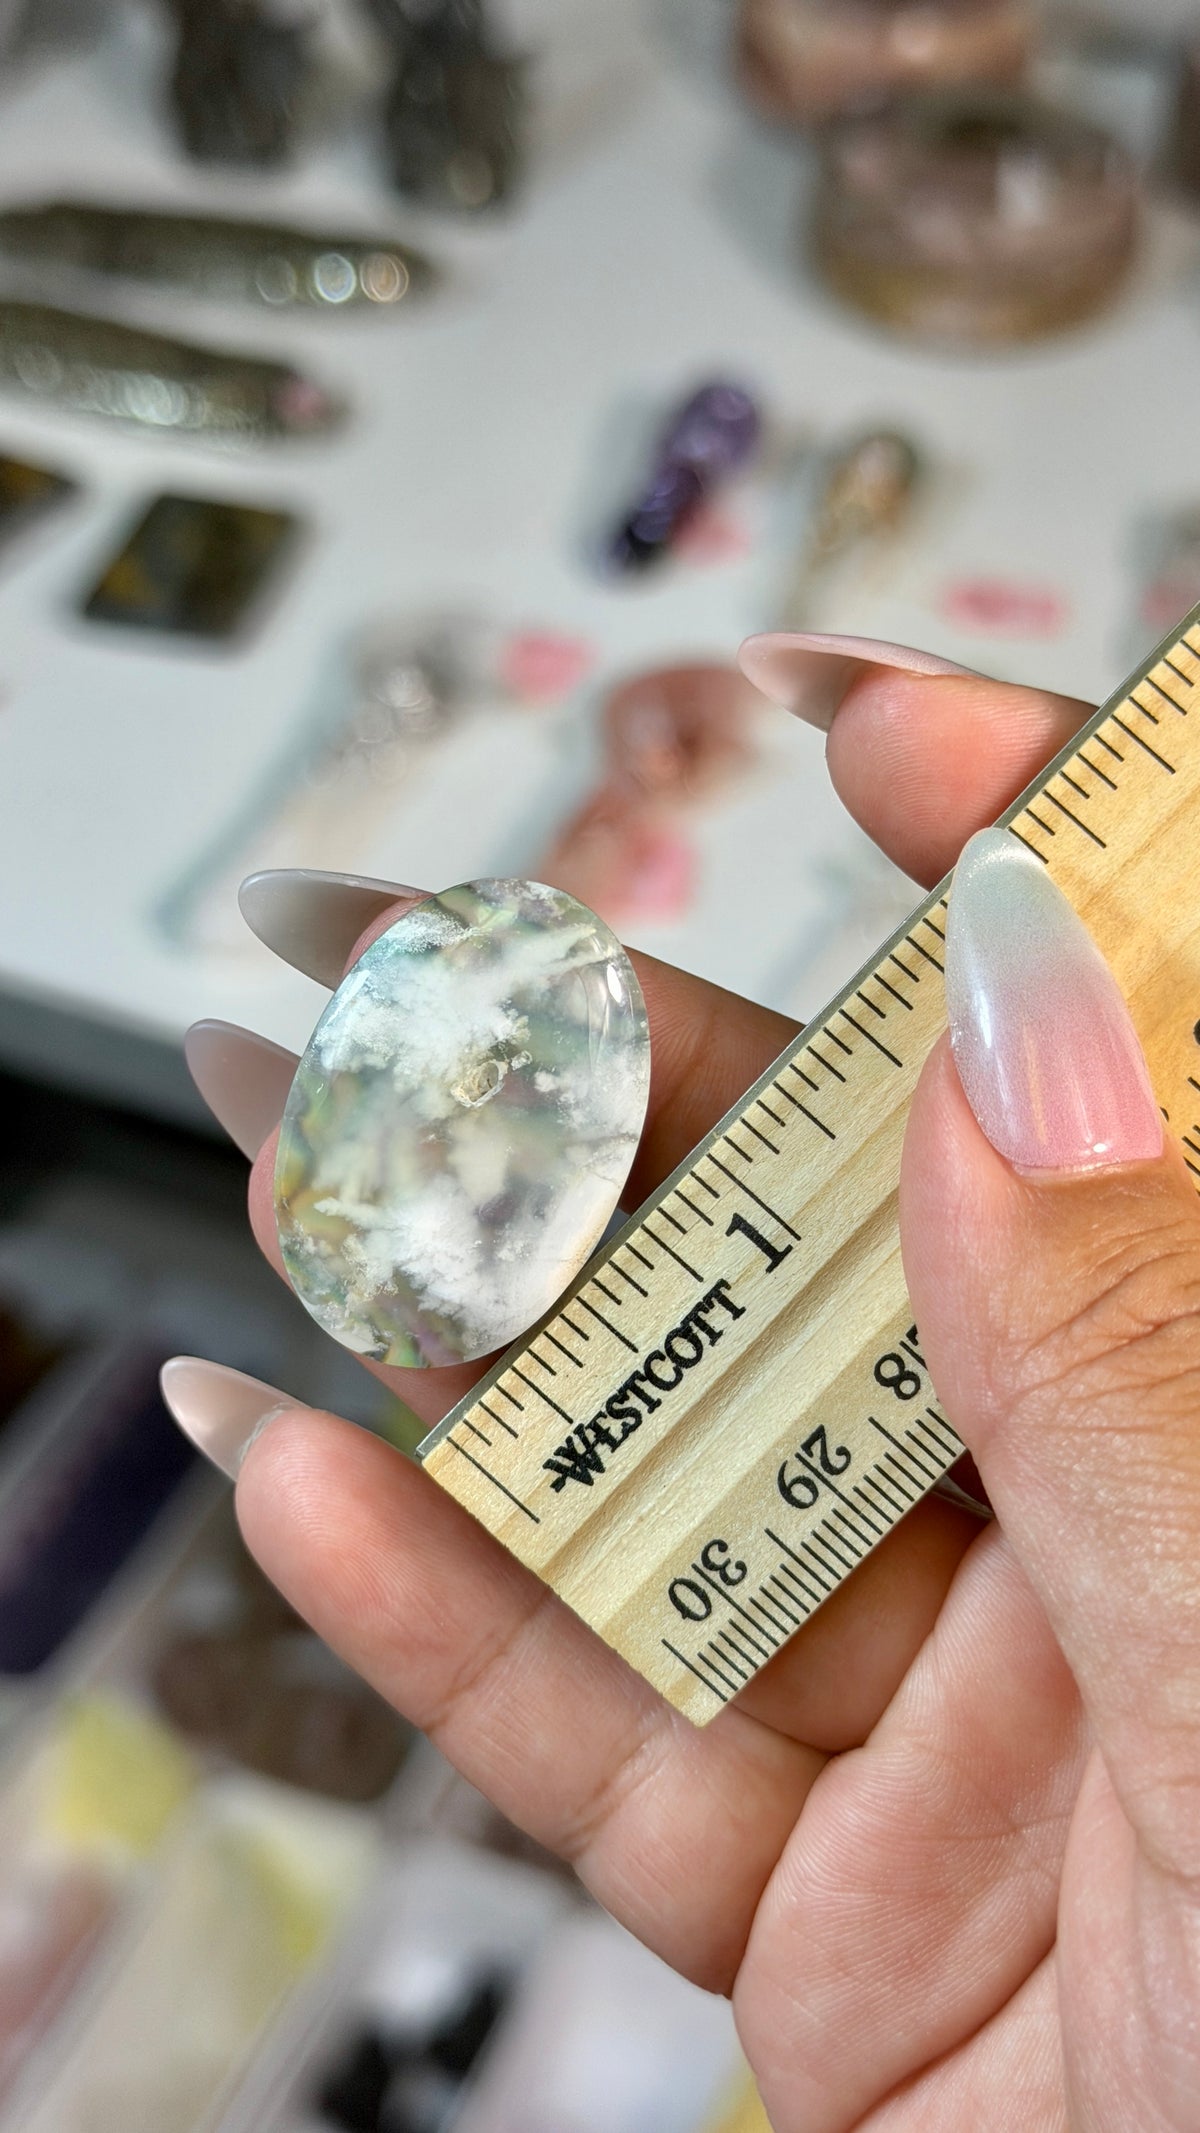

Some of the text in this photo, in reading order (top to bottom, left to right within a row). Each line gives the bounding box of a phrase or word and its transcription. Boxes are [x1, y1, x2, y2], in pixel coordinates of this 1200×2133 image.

[725, 1212, 794, 1274] 1
[544, 1278, 746, 1493] WESTCOTT
[777, 1425, 851, 1509] 29
[668, 1540, 748, 1622] 30
